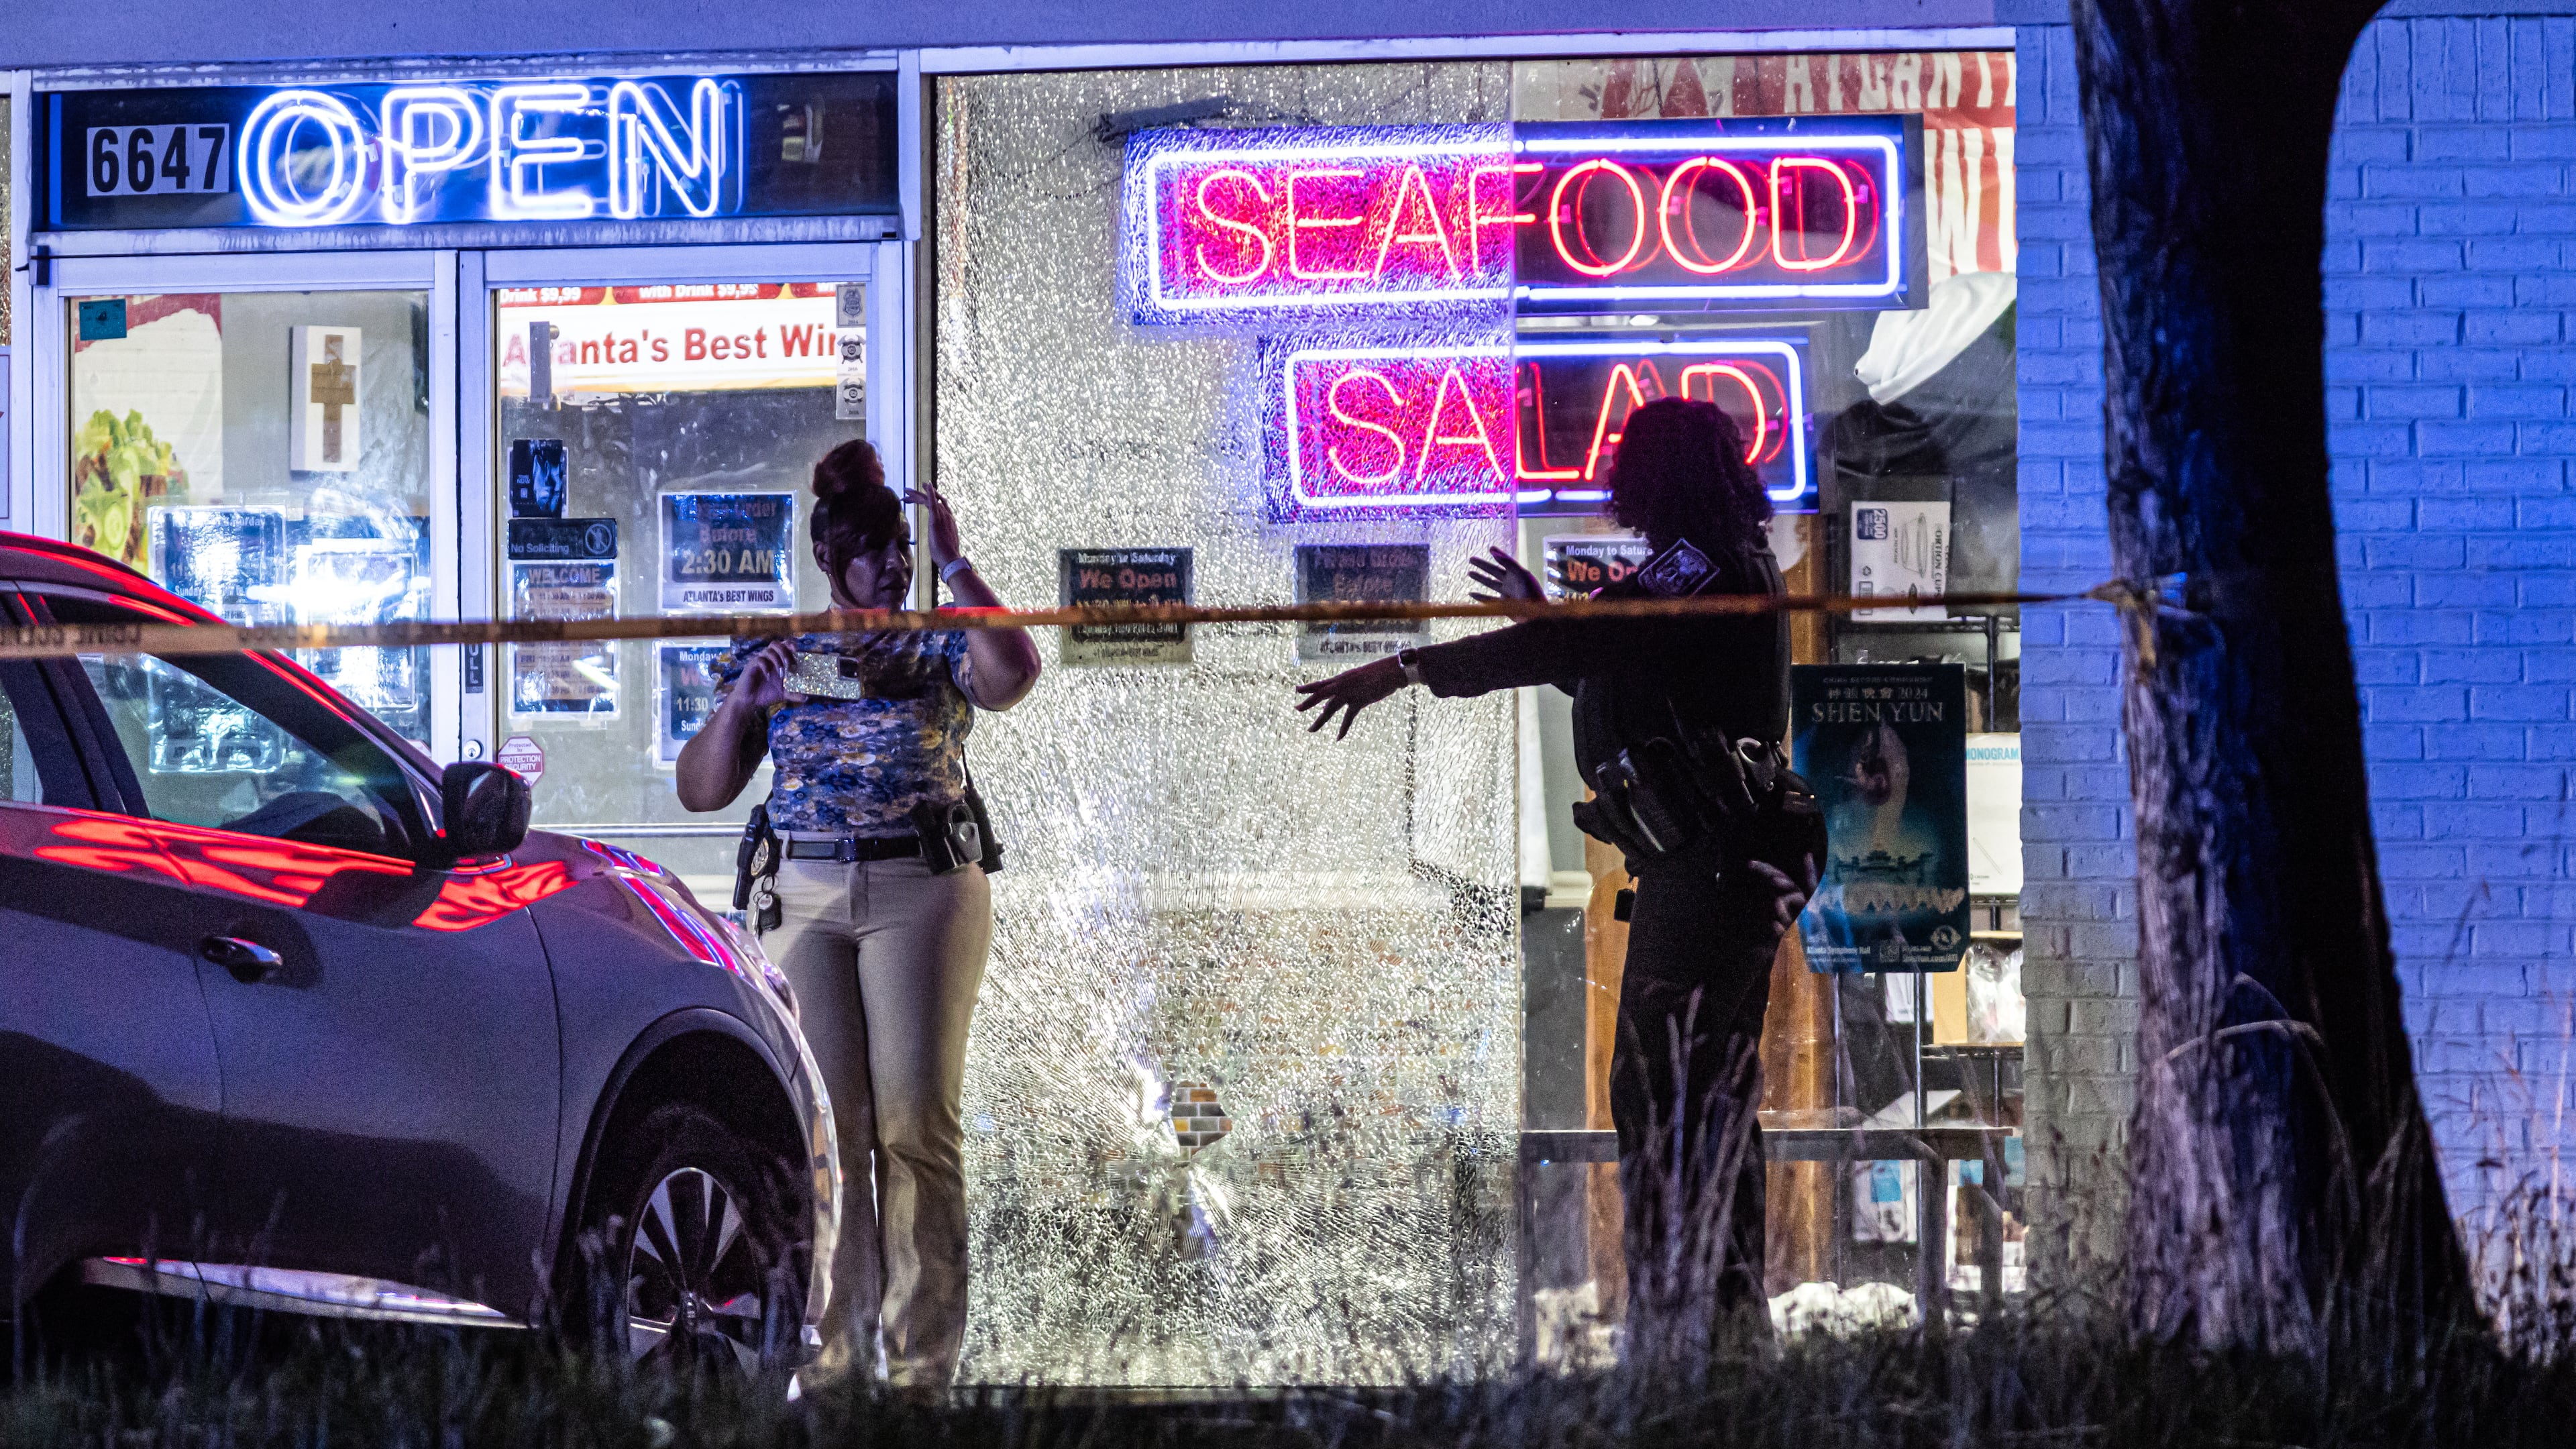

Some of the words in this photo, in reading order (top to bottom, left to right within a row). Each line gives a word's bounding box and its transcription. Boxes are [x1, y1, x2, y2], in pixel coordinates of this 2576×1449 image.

[92, 127, 225, 192] 6647
[238, 78, 720, 228] OPEN
[1196, 158, 1856, 283] SEAFOOD
[502, 329, 669, 367] Aanta's
[684, 326, 767, 360] Best
[1874, 509, 1886, 539] 2500
[511, 544, 524, 553] No
[526, 543, 570, 554] Soliciting
[1566, 545, 1604, 558] Monday
[1607, 545, 1617, 555] to
[1620, 545, 1654, 556] Satur
[1935, 523, 1943, 570] ORTION
[682, 549, 731, 574] 2:30
[739, 549, 775, 574] AM
[1566, 559, 1601, 582] We
[529, 568, 600, 584] WELCOME
[1079, 569, 1114, 588] We
[1119, 568, 1177, 594] Open
[684, 591, 724, 602] ATLANTA's
[726, 590, 746, 602] BEST
[748, 590, 774, 602] WINGS
[470, 641, 479, 684] ULL
[680, 651, 716, 661] Monday
[677, 698, 709, 712] 11:30
[1812, 702, 1880, 722] SHEN
[1891, 702, 1943, 722] YUN
[500, 755, 541, 763] PROTECTION
